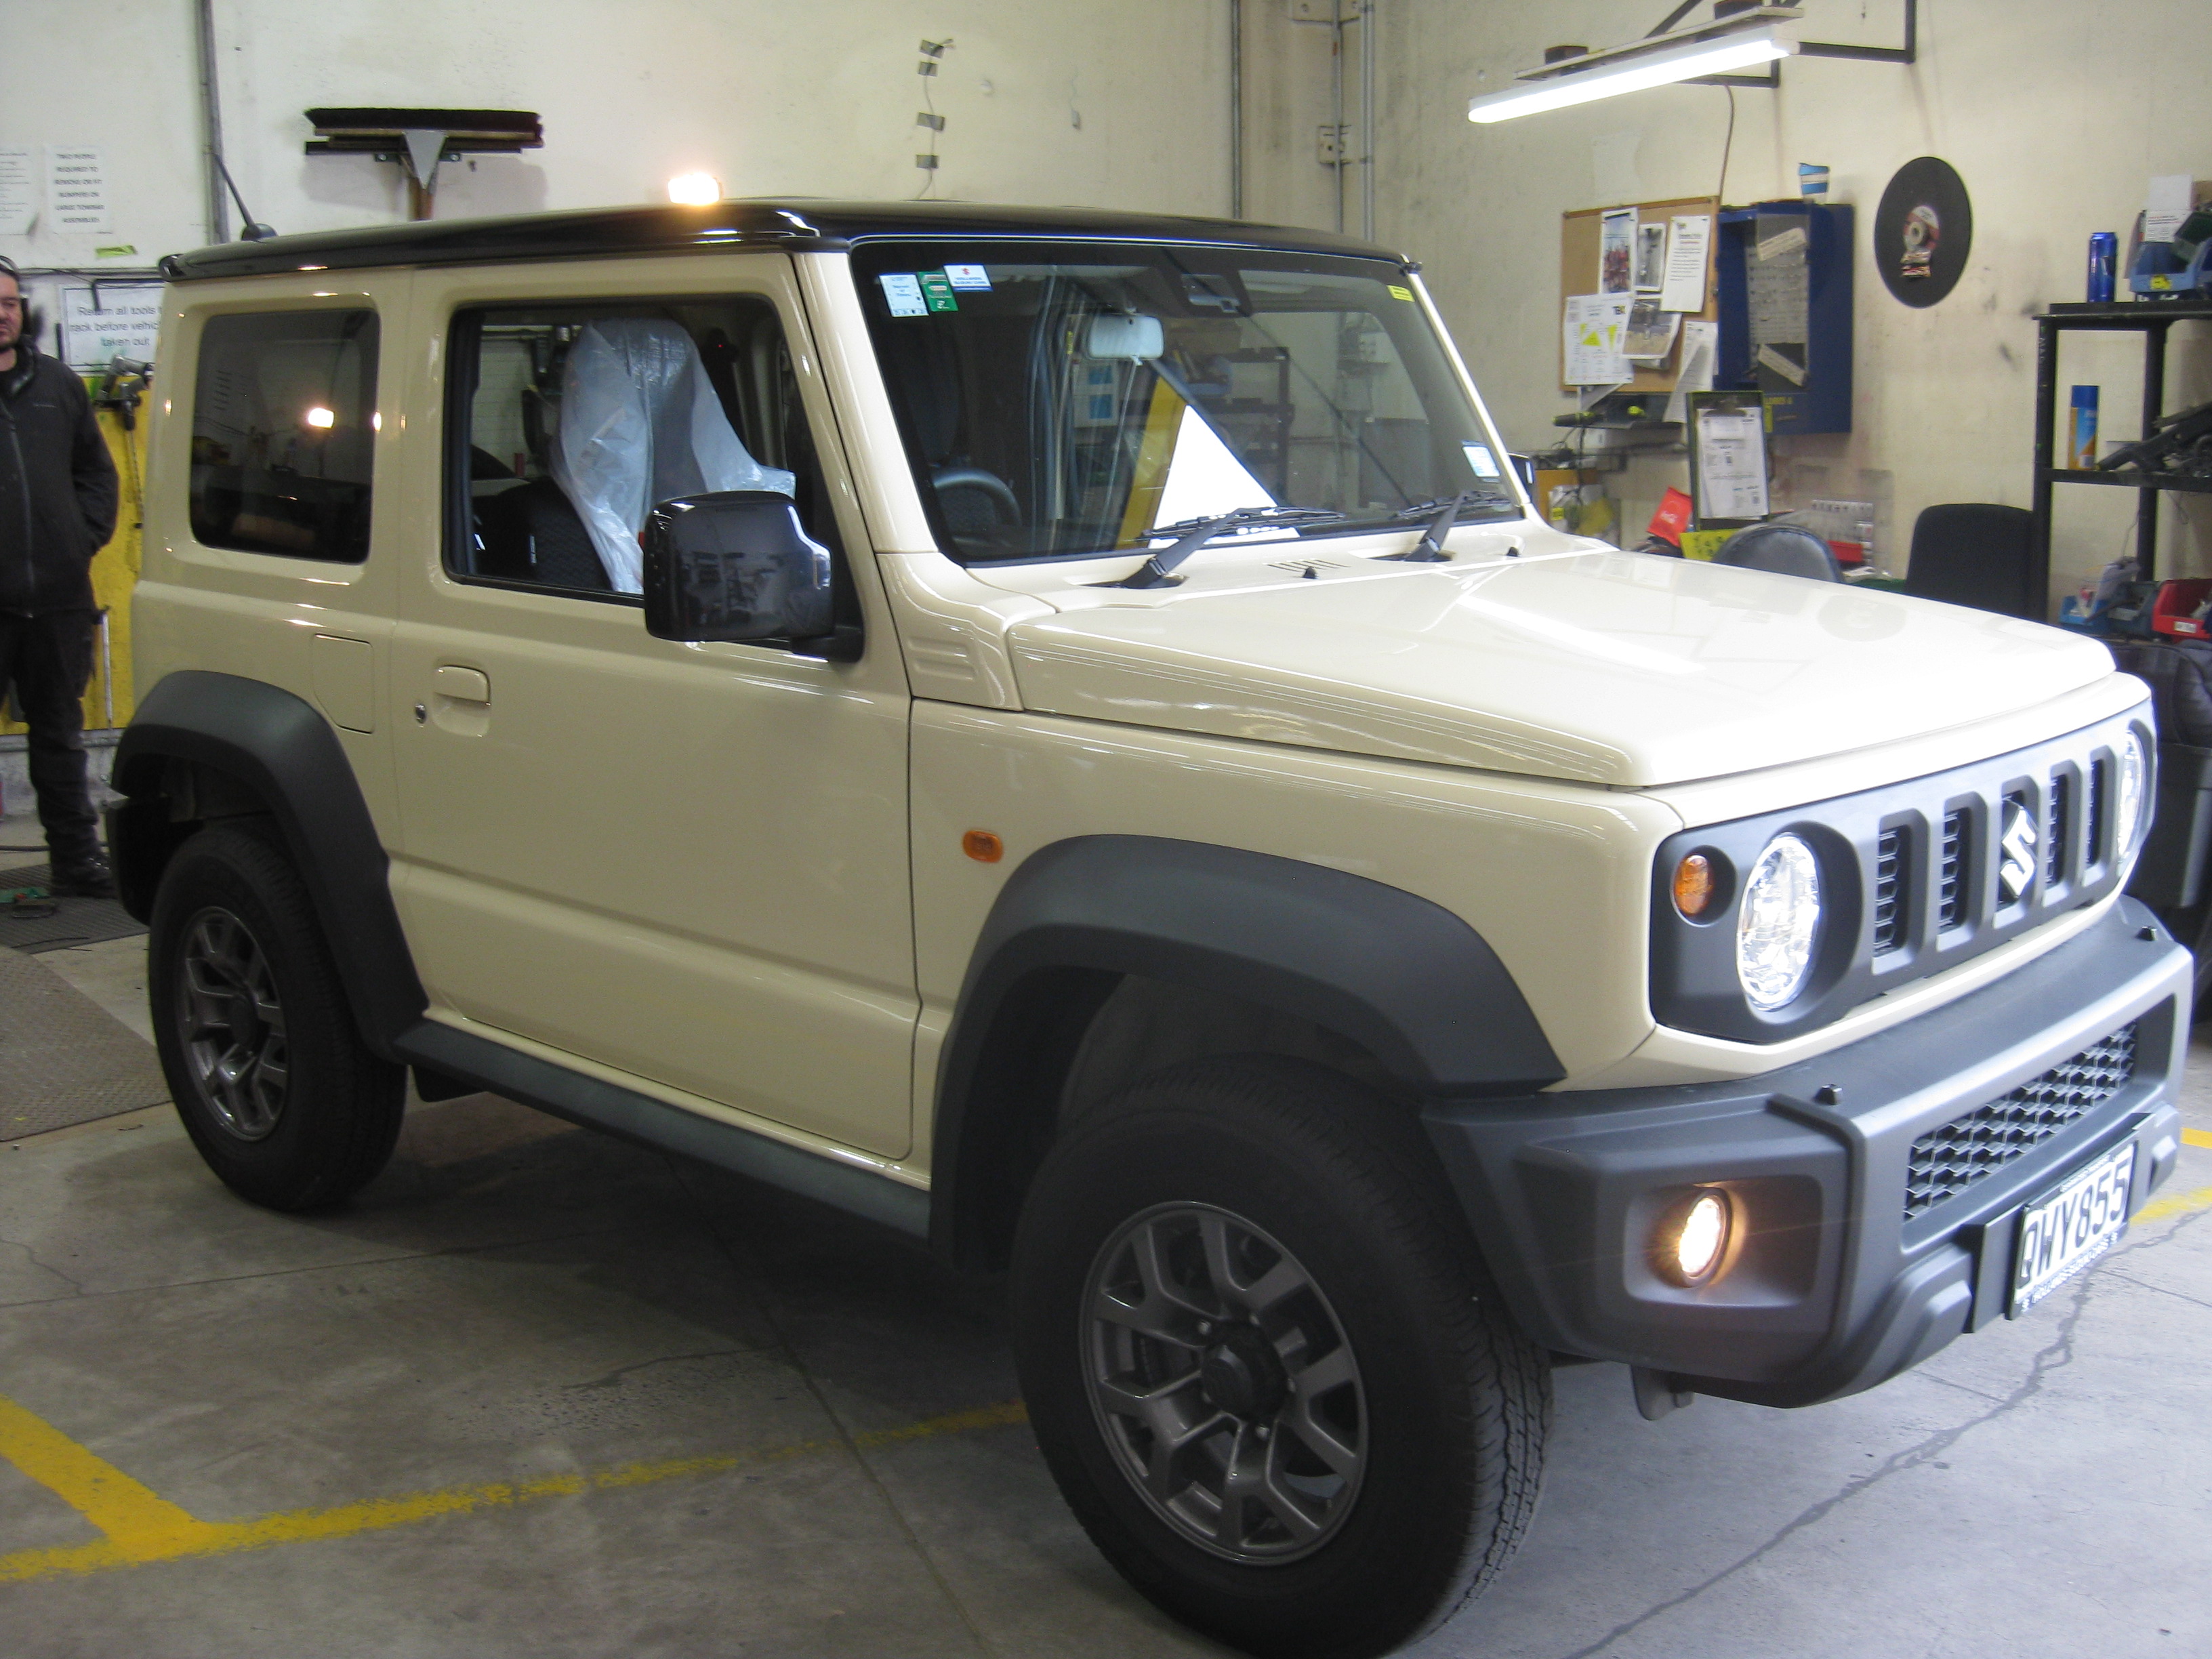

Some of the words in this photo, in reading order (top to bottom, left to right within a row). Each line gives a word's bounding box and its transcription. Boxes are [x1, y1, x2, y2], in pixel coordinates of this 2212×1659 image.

[116, 306, 127, 316] all
[130, 305, 157, 315] tools
[69, 323, 93, 333] rack
[94, 322, 129, 331] before
[100, 336, 131, 347] taken
[132, 336, 150, 346] out
[2015, 1159, 2131, 1289] QWY855
